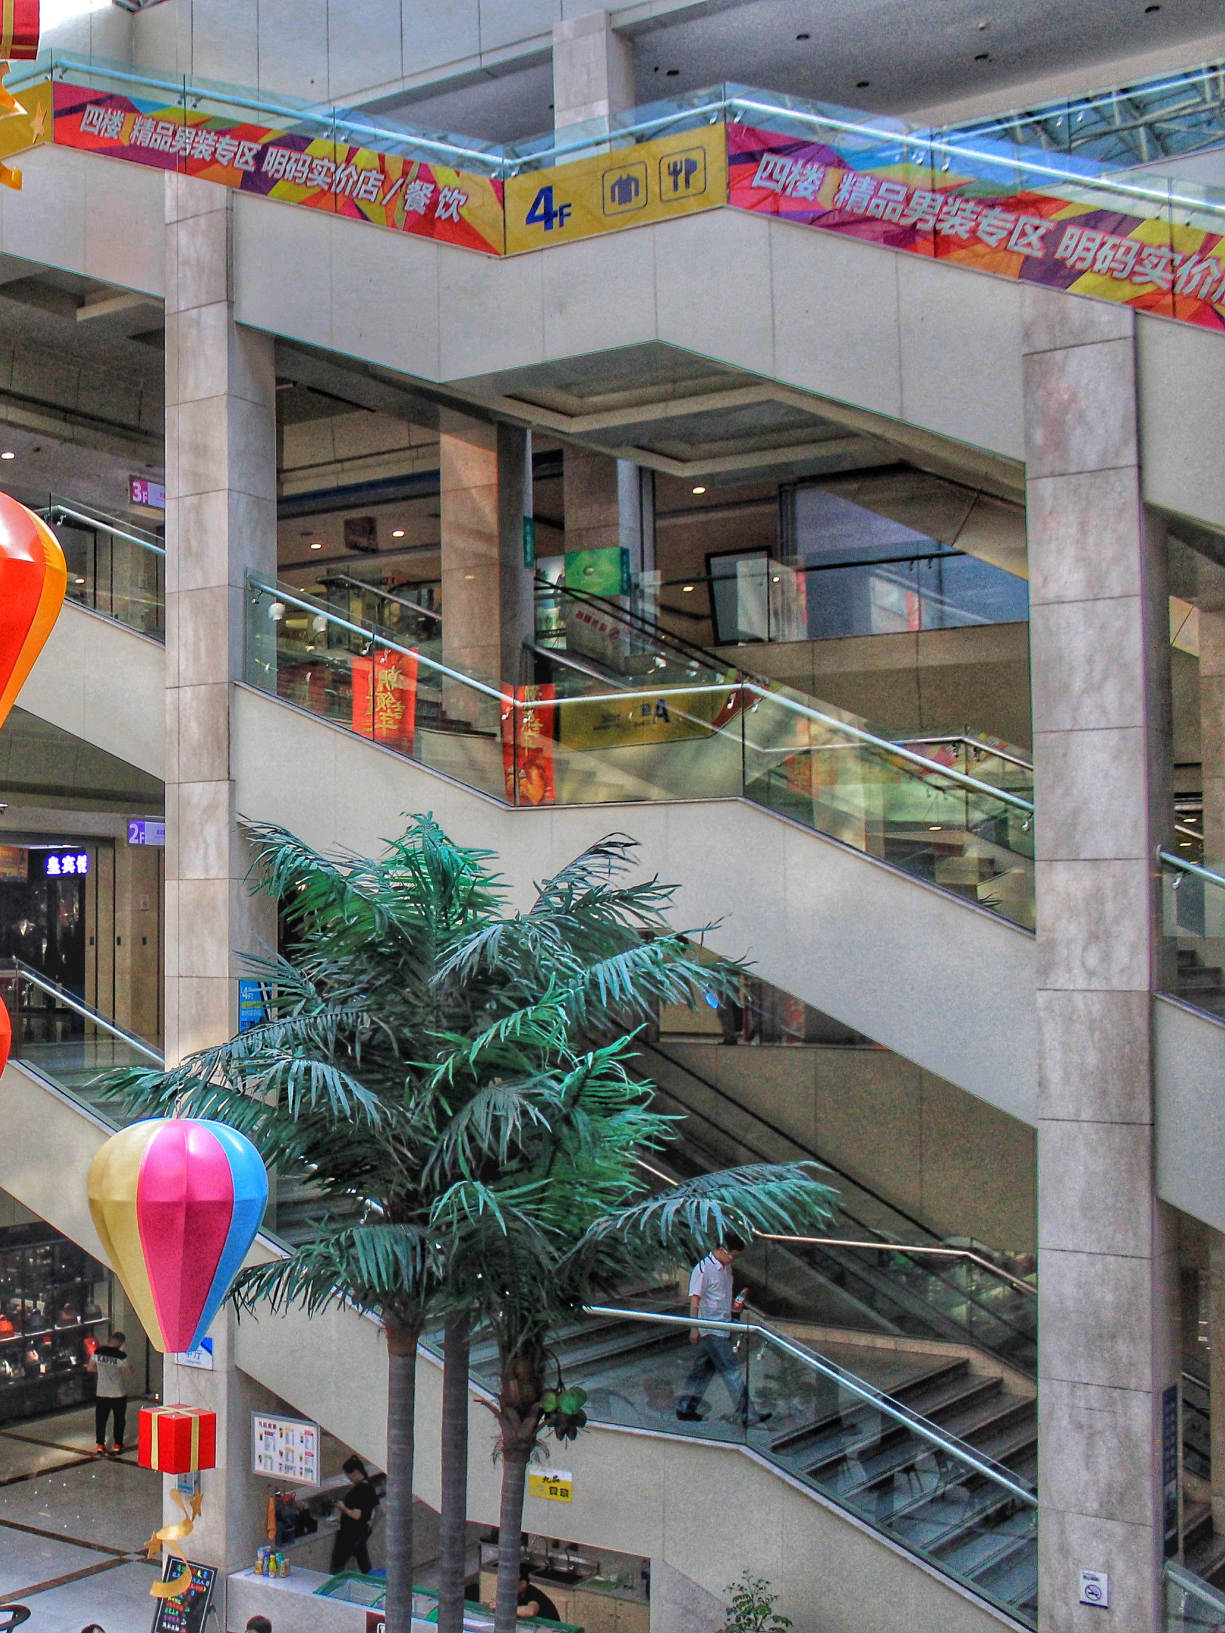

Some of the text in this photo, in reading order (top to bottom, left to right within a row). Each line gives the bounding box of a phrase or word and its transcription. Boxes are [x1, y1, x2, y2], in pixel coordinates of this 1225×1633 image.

[79, 103, 125, 140] 四楼
[129, 116, 262, 172] 精品男装专区
[262, 146, 386, 201] 明码实价店
[404, 179, 467, 223] 餐饮
[524, 184, 573, 232] 4F
[751, 153, 1225, 304] 四楼 精品男装专区 明码实价
[131, 481, 148, 504] 3F
[128, 822, 146, 845] 2F
